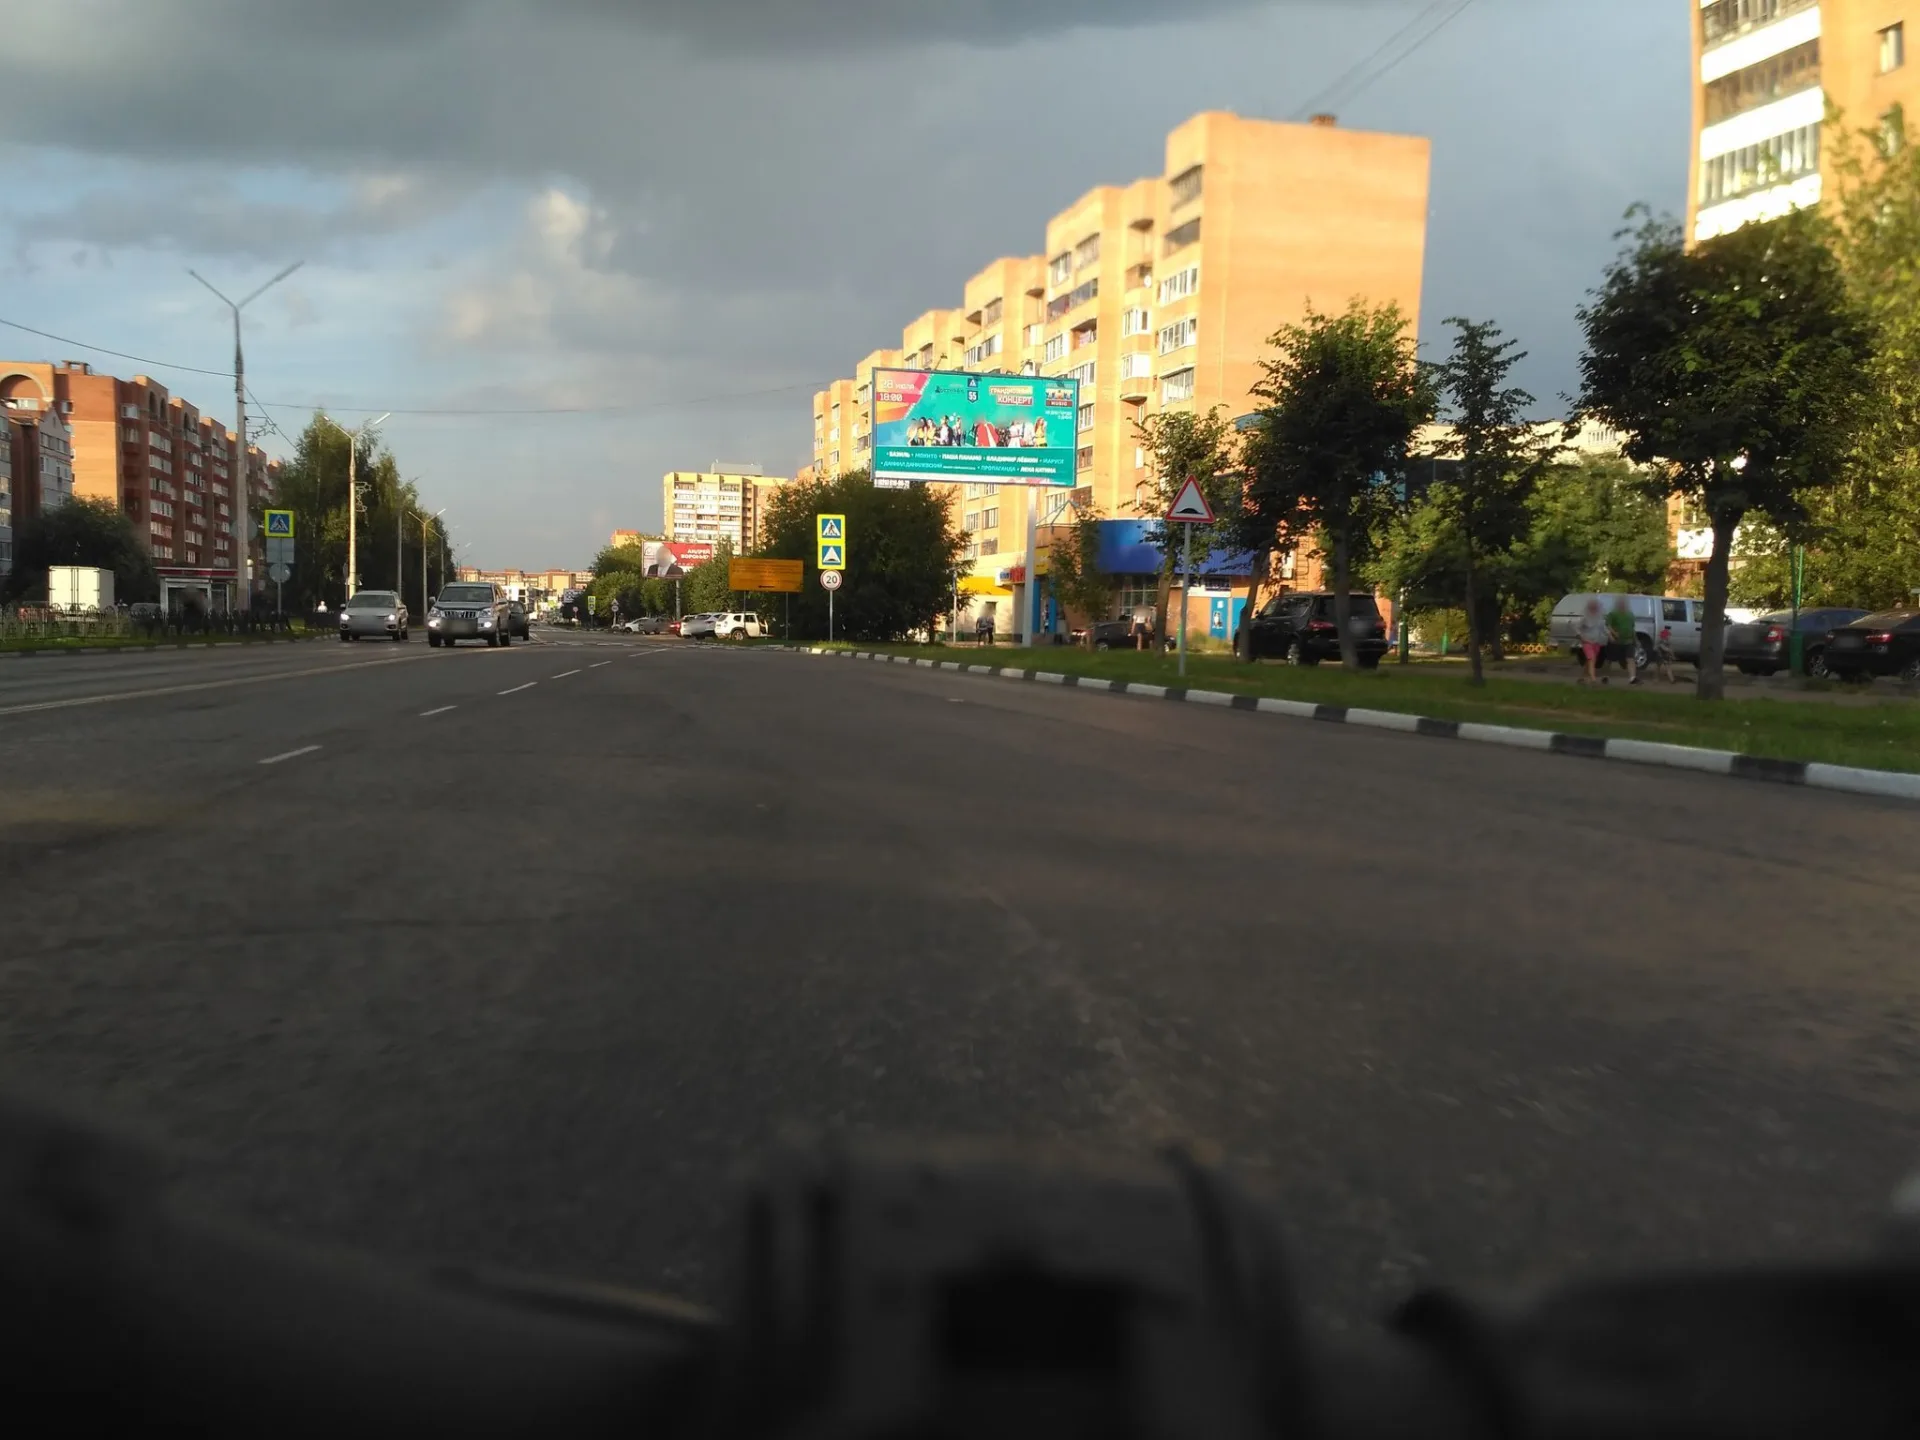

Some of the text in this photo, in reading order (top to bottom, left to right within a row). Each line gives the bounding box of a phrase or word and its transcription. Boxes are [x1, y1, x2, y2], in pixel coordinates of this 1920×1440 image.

[880, 392, 903, 402] 18:00
[968, 391, 977, 400] 55
[997, 395, 1032, 405] КОНЦЕРТ
[826, 575, 838, 584] 20
